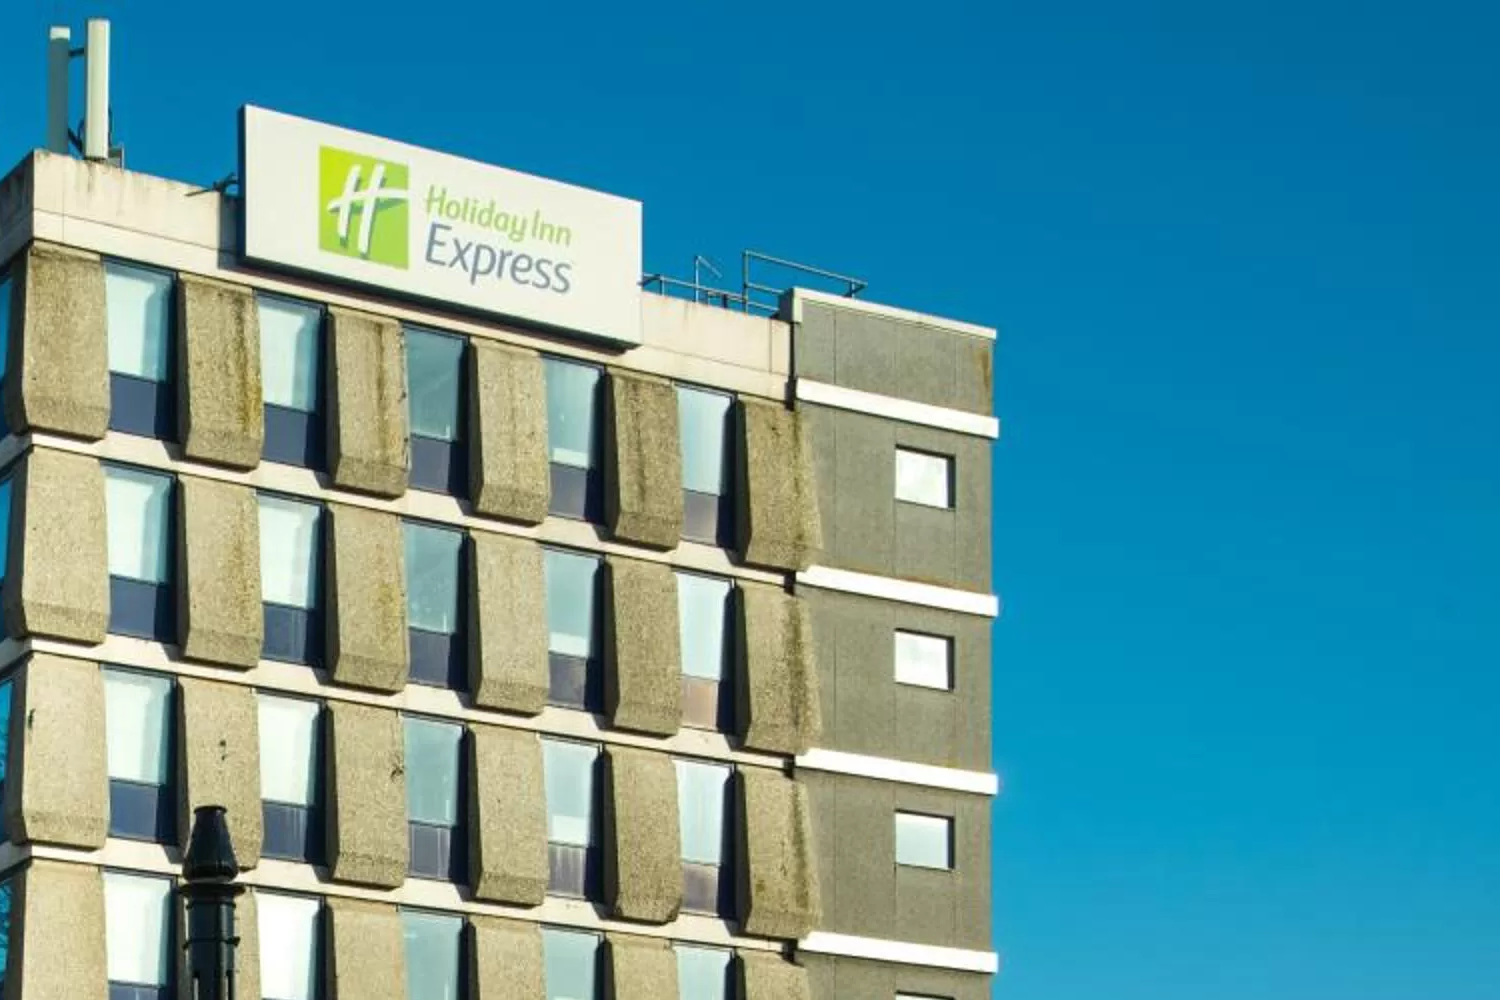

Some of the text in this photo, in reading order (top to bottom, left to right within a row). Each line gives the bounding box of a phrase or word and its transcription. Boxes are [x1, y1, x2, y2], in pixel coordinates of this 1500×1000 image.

[425, 184, 572, 247] Holiday Inn
[425, 221, 573, 294] Express
